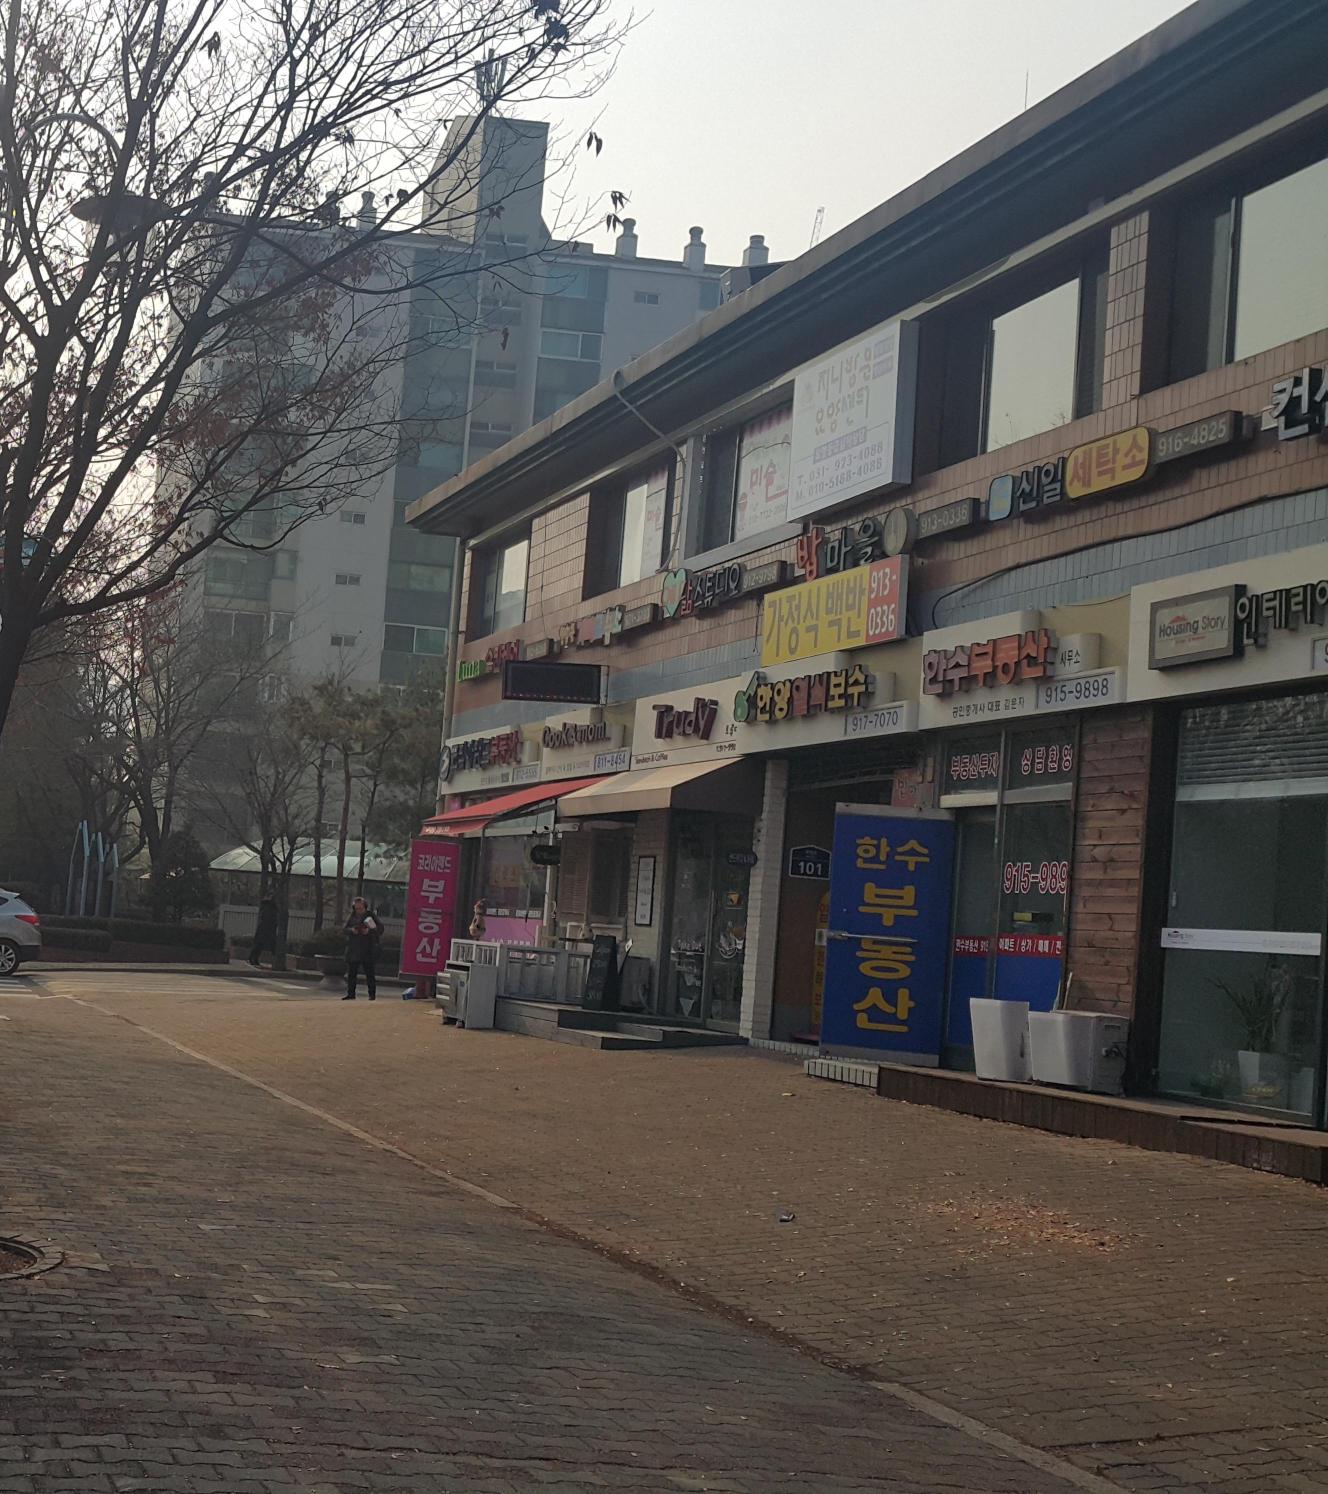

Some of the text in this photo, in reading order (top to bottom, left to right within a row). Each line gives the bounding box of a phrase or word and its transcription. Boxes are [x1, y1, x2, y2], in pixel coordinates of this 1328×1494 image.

[1157, 417, 1227, 457] 916-4825
[1069, 430, 1147, 489] 세탁소
[1016, 457, 1065, 508] 신일
[868, 604, 896, 636] 0336
[1158, 613, 1227, 638] Housing Story
[923, 628, 1049, 695] 한수부동산
[1044, 676, 1110, 705] 915-9898
[850, 709, 900, 733] 917-7070
[951, 751, 999, 780] 부동산투자
[798, 861, 823, 876] 101
[855, 835, 930, 872] 한수
[415, 878, 446, 964] 부동산
[852, 881, 920, 1033] 부동산
